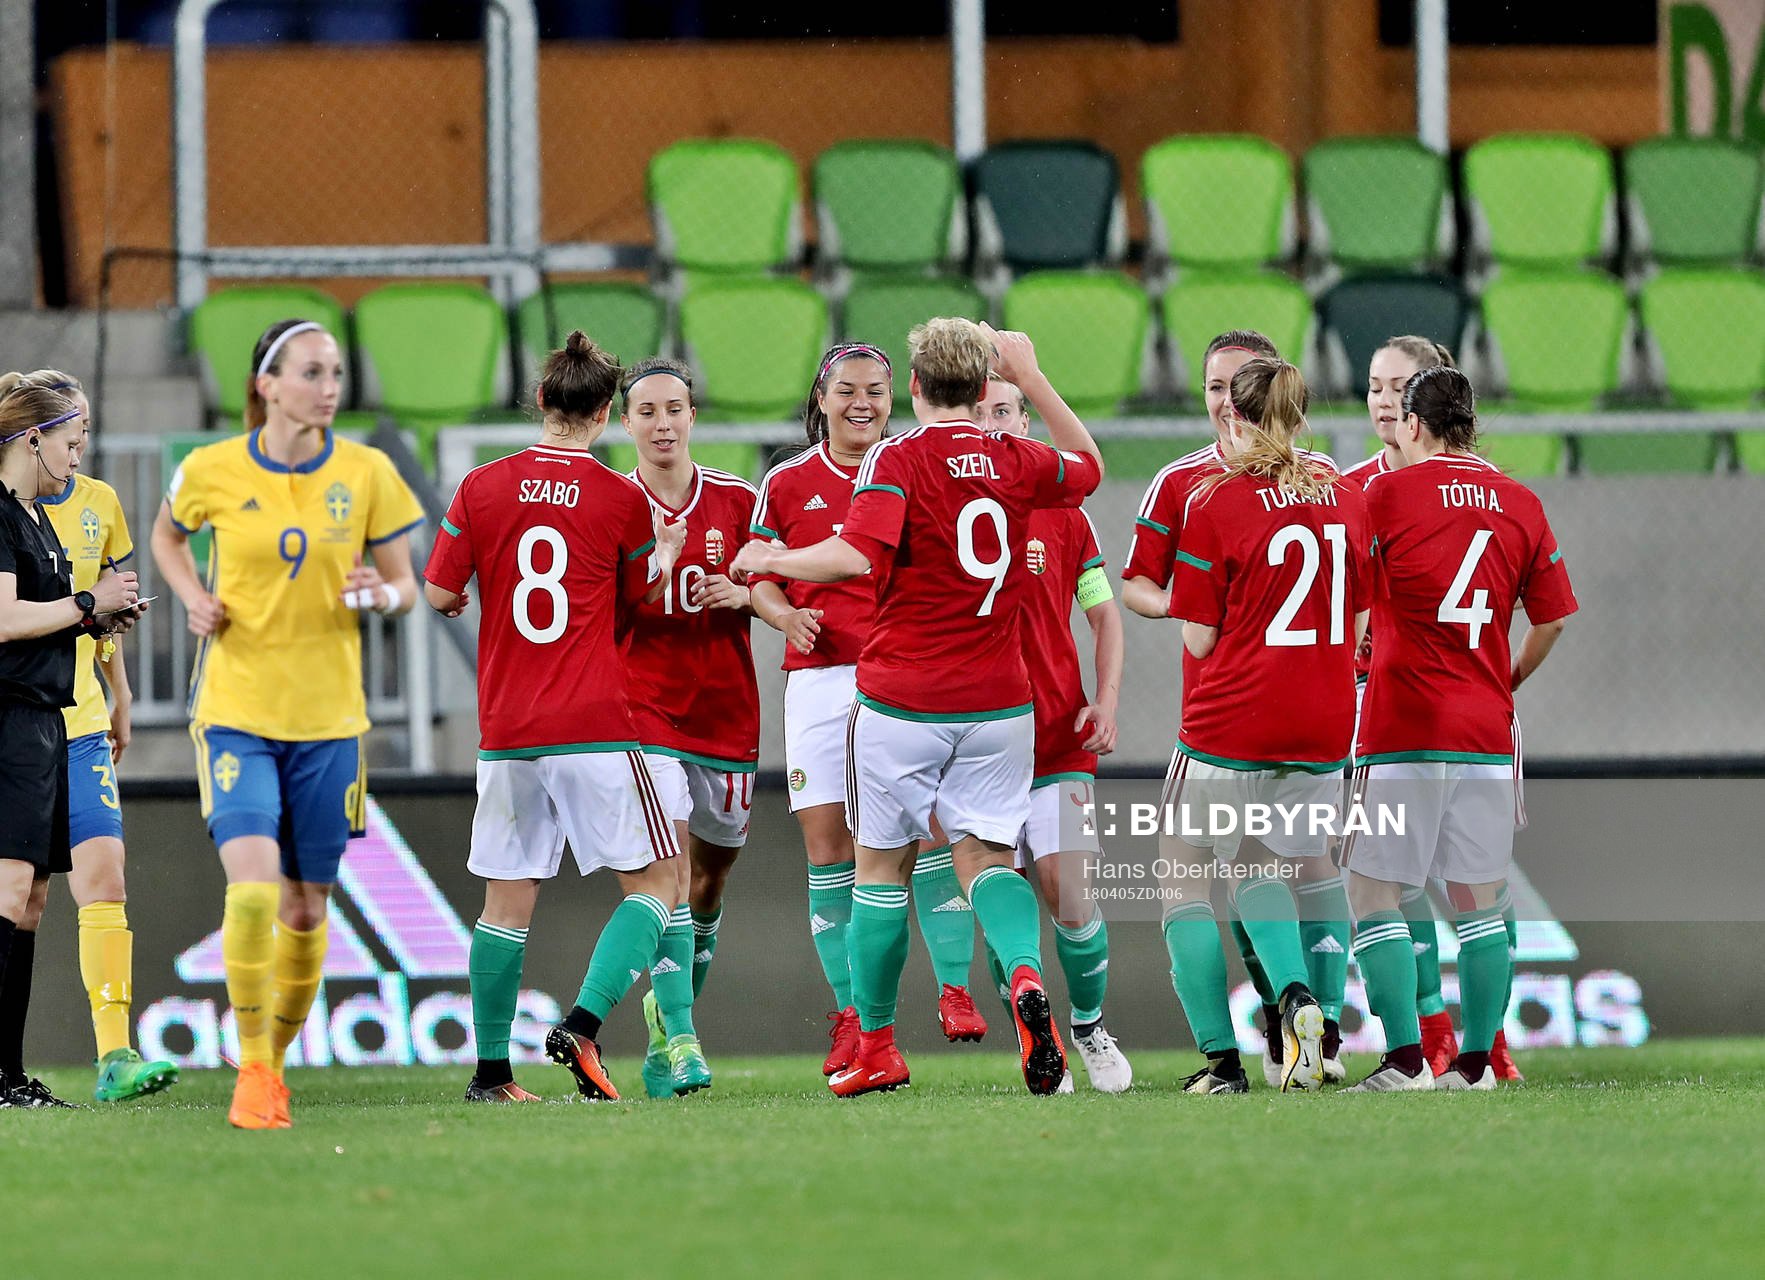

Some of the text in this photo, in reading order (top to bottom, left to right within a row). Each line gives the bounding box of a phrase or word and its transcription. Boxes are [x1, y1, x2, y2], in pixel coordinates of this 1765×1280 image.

[1670, 4, 1765, 139] D
[279, 527, 308, 579] 9
[518, 479, 580, 509] SZABÓ
[1255, 484, 1338, 512] TURYI
[512, 526, 569, 644] 8
[957, 498, 1012, 616] 9
[1265, 523, 1347, 647] 21
[1437, 529, 1494, 650] 4
[91, 765, 119, 809] 3
